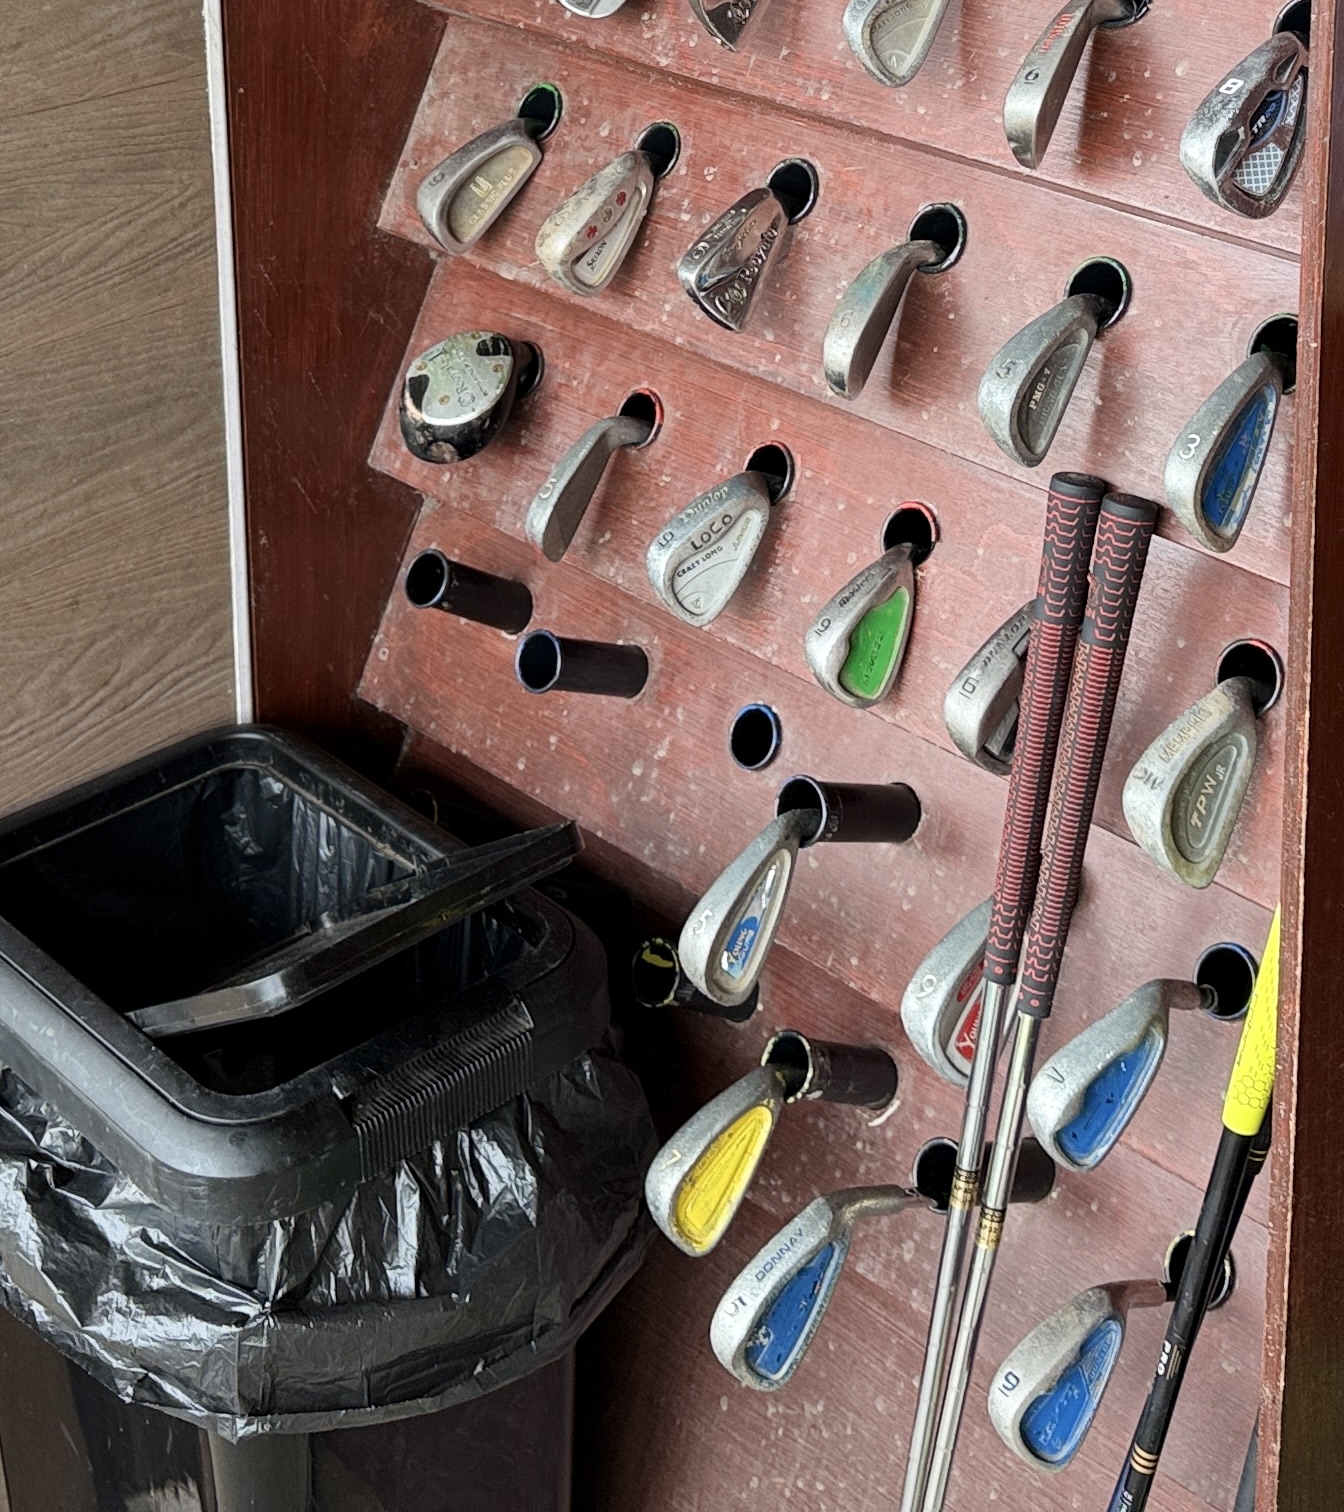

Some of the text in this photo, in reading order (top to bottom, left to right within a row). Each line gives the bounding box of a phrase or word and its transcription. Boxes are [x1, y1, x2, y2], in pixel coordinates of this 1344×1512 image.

[1218, 78, 1245, 95] 8
[468, 167, 516, 226] CLASSIC PLUS
[1028, 382, 1046, 411] PMG
[1179, 433, 1201, 460] 3
[538, 477, 558, 500] 5
[679, 486, 729, 524] Dunlop
[690, 513, 734, 551] LOCO
[676, 545, 724, 578] CRAZY LONG
[817, 617, 832, 634] 9
[961, 676, 980, 695] 6
[1159, 707, 1213, 764] MEMPHIS
[1190, 764, 1227, 829] TPW JR
[692, 908, 713, 935] 5
[916, 974, 938, 999] 9
[659, 1149, 681, 1171] 7
[754, 1227, 804, 1283] DONNAY
[1157, 1339, 1172, 1376] PRO
[1002, 1370, 1022, 1393] 9
